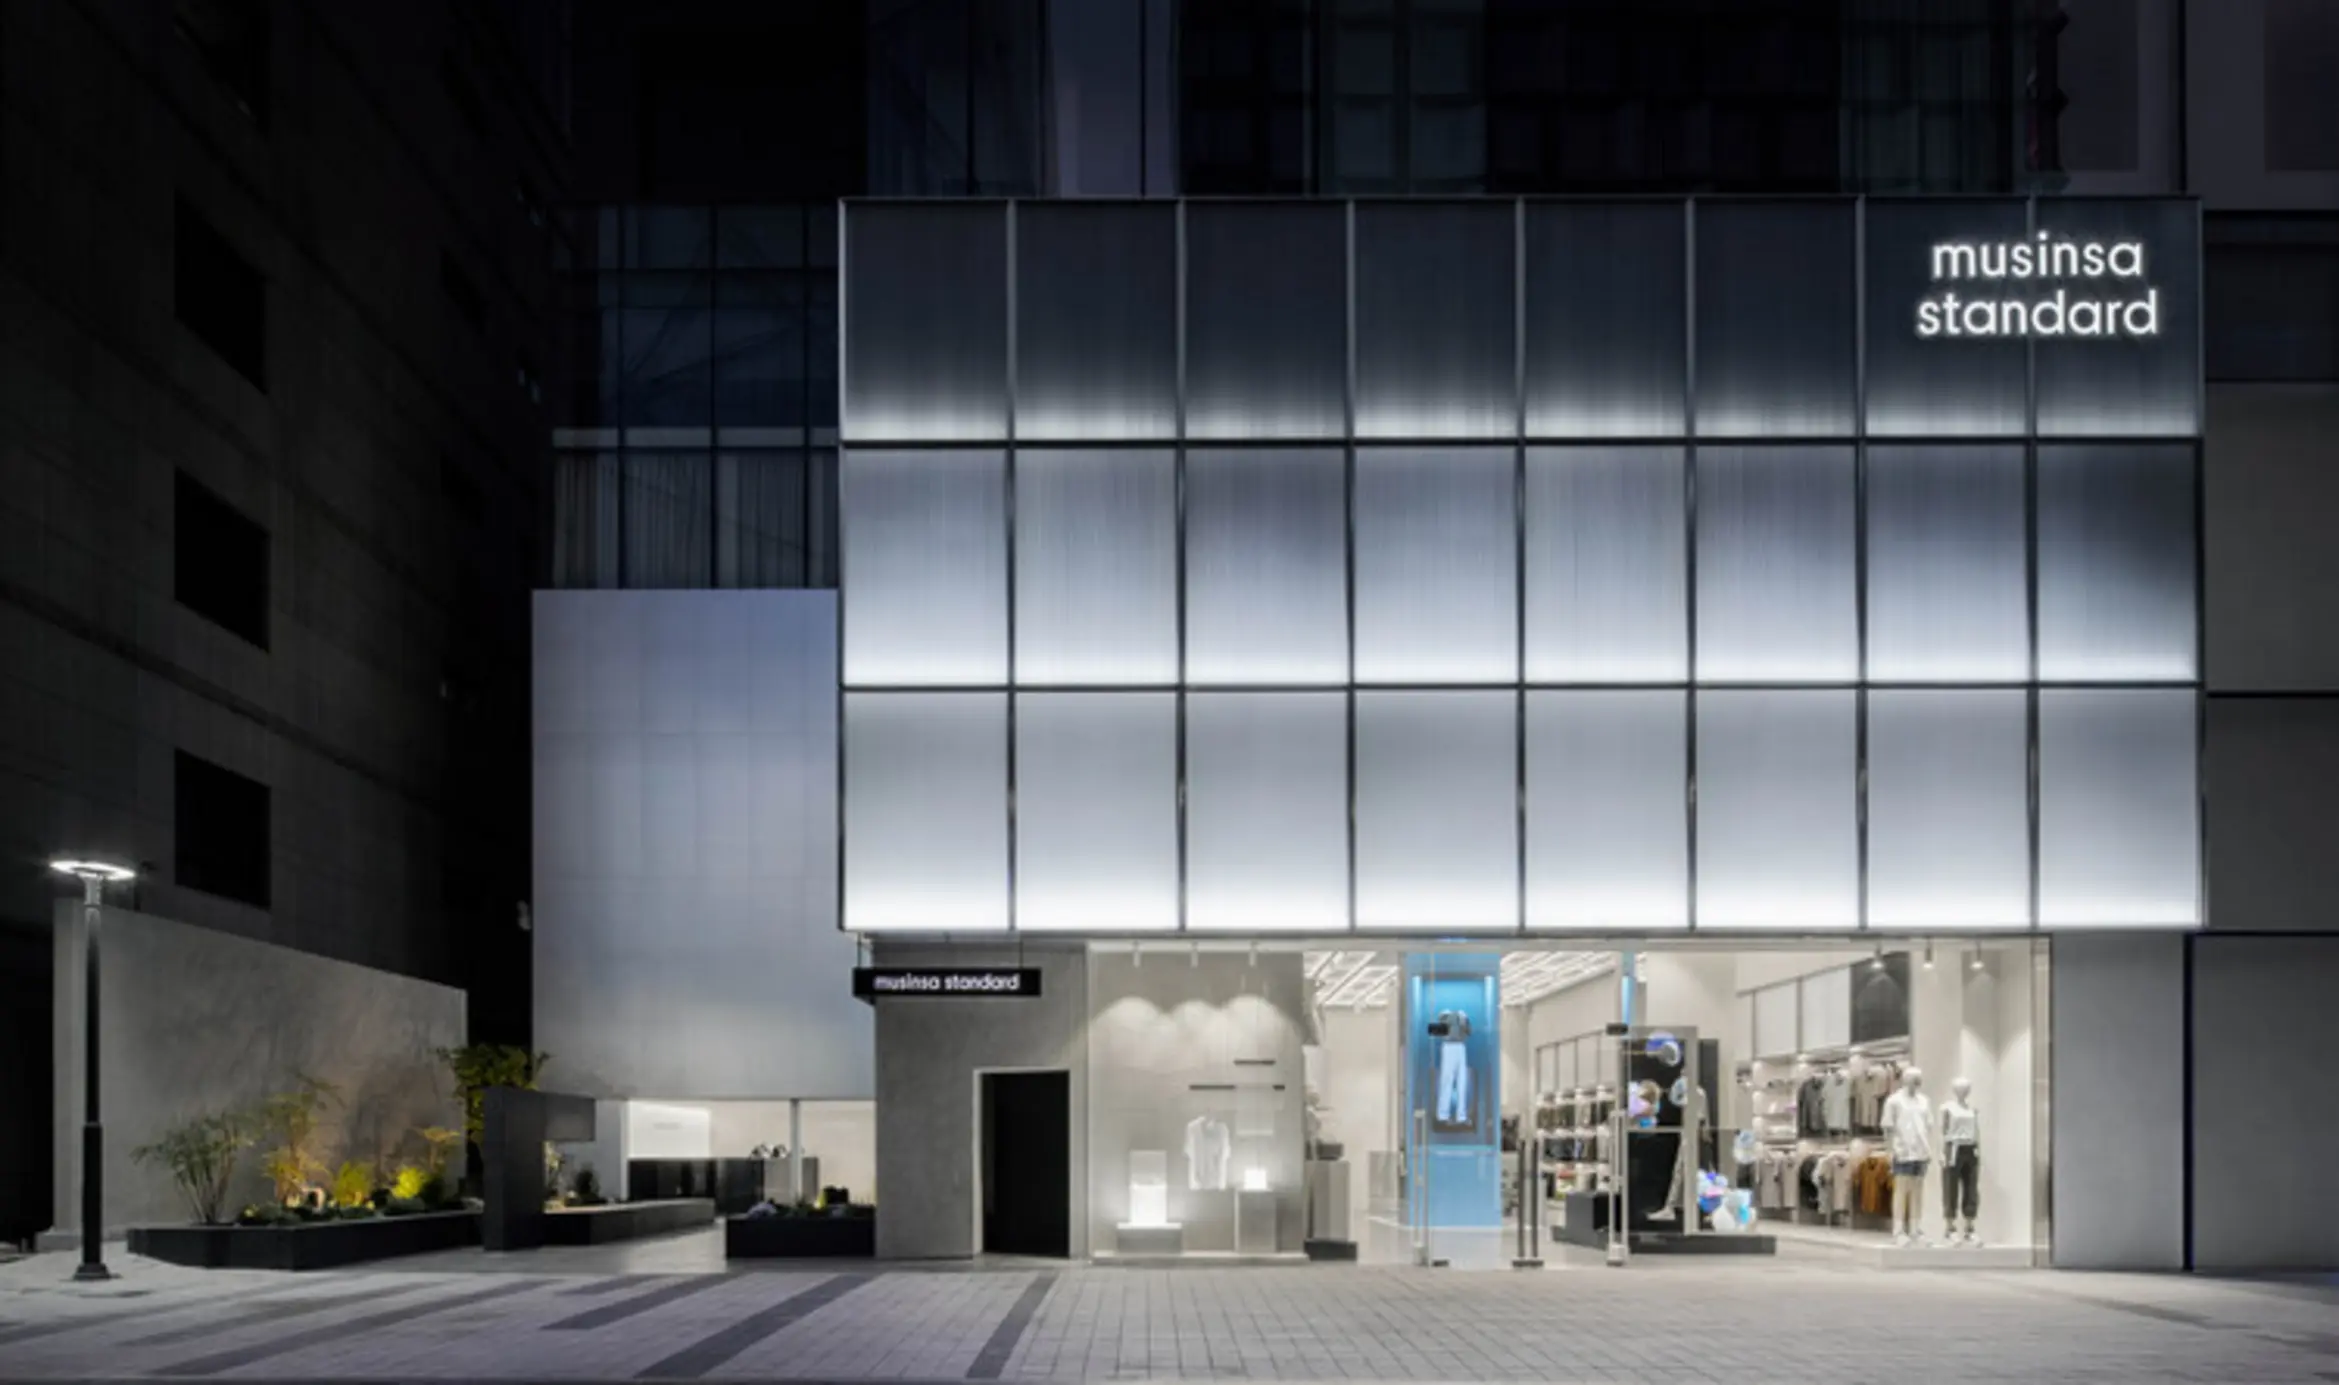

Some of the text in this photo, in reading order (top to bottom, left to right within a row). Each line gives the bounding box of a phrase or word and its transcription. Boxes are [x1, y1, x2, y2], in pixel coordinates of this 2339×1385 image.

[1932, 230, 2143, 278] musinsa
[1916, 288, 2158, 336] standard
[874, 973, 1020, 990] musinsa standard
